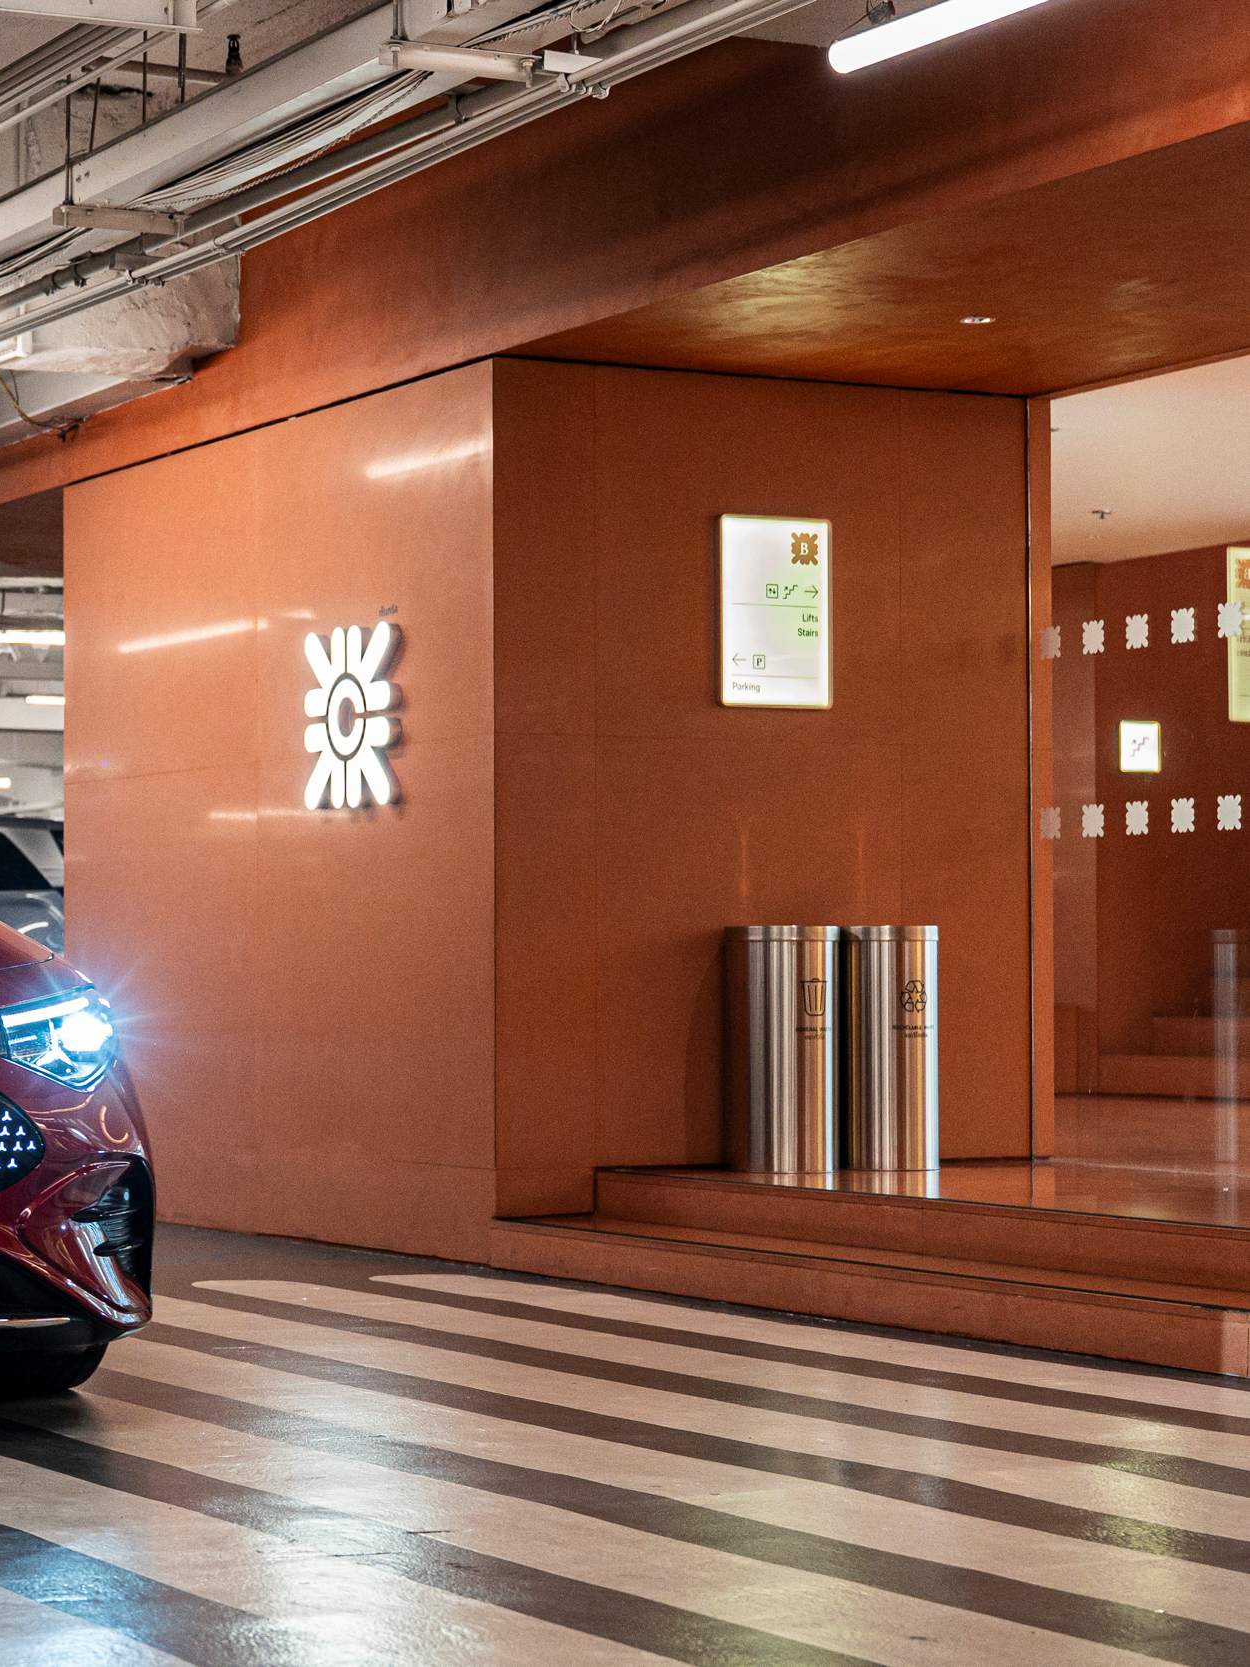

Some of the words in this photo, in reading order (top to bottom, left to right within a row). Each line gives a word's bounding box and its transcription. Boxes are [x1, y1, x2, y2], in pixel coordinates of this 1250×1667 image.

[800, 542, 809, 556] B
[802, 613, 819, 623] Lifts
[797, 627, 819, 637] Stairs
[732, 681, 761, 694] Parking
